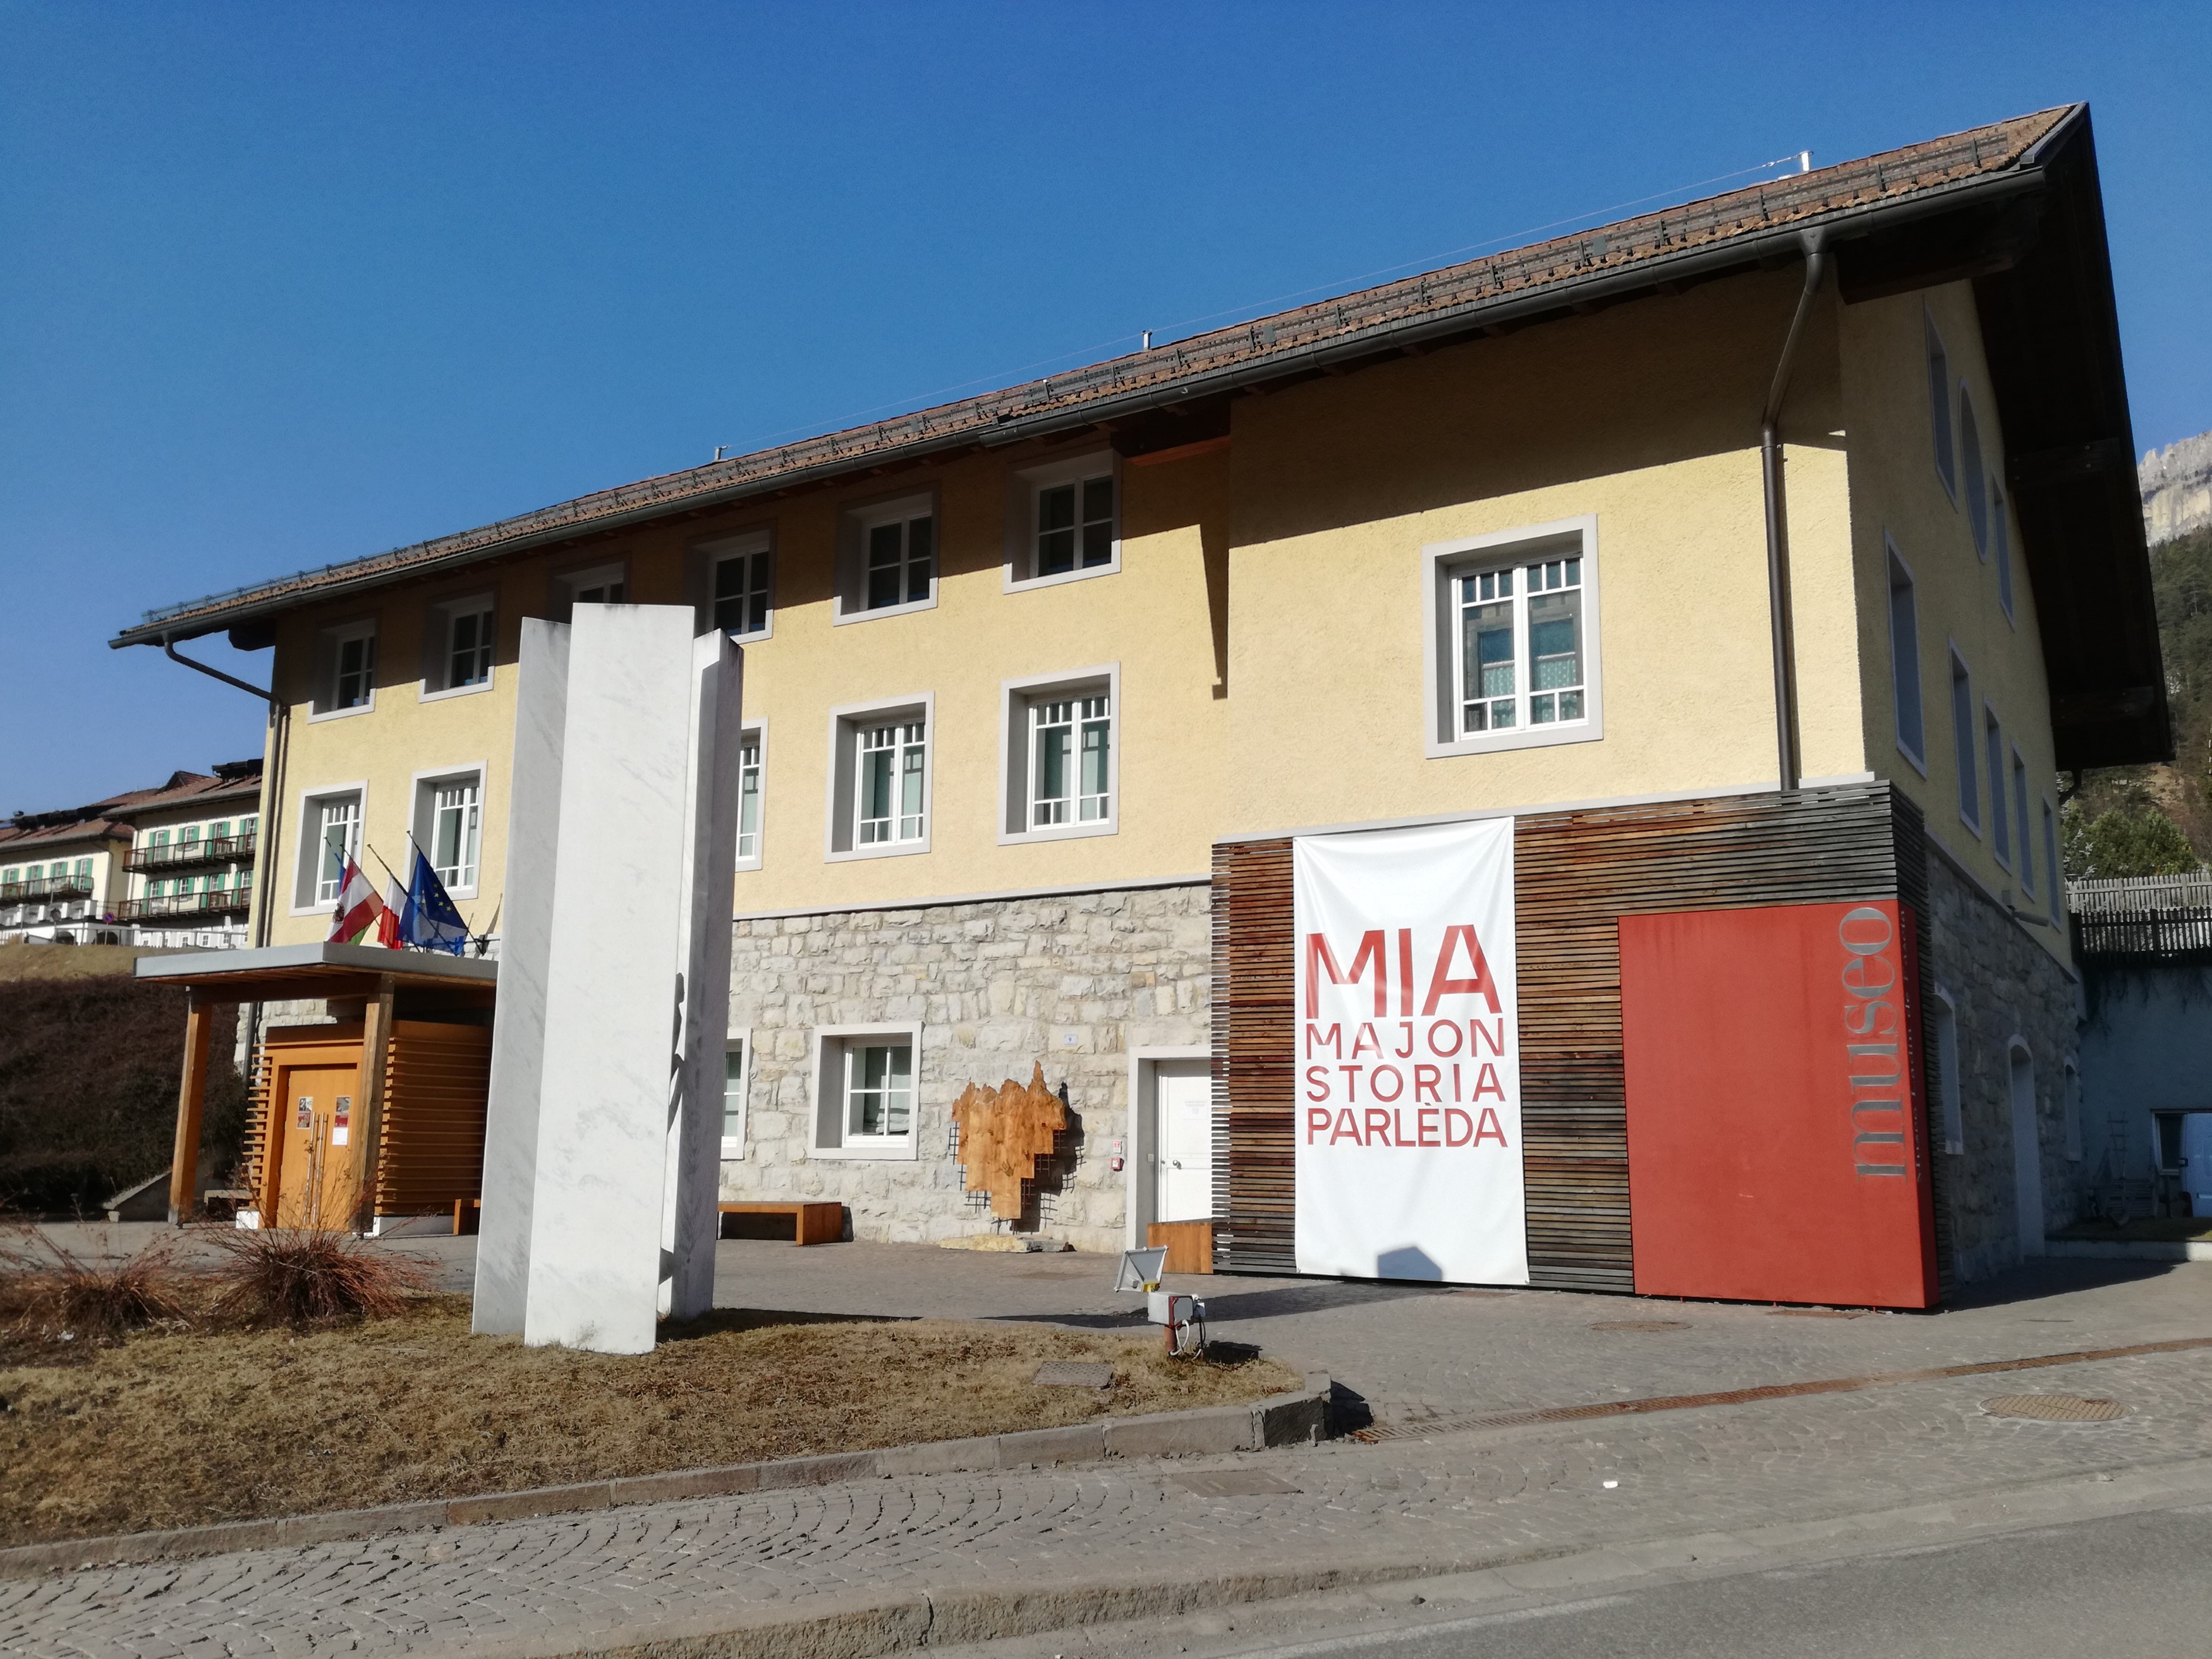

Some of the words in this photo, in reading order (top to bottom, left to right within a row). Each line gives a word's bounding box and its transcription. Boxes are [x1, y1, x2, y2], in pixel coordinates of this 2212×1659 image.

[1306, 925, 1502, 1019] MIA
[1306, 1018, 1504, 1060] MAJON
[1840, 908, 1907, 1182] museo
[1306, 1064, 1505, 1102] STORIA
[1308, 1103, 1508, 1147] PARLÈDA
